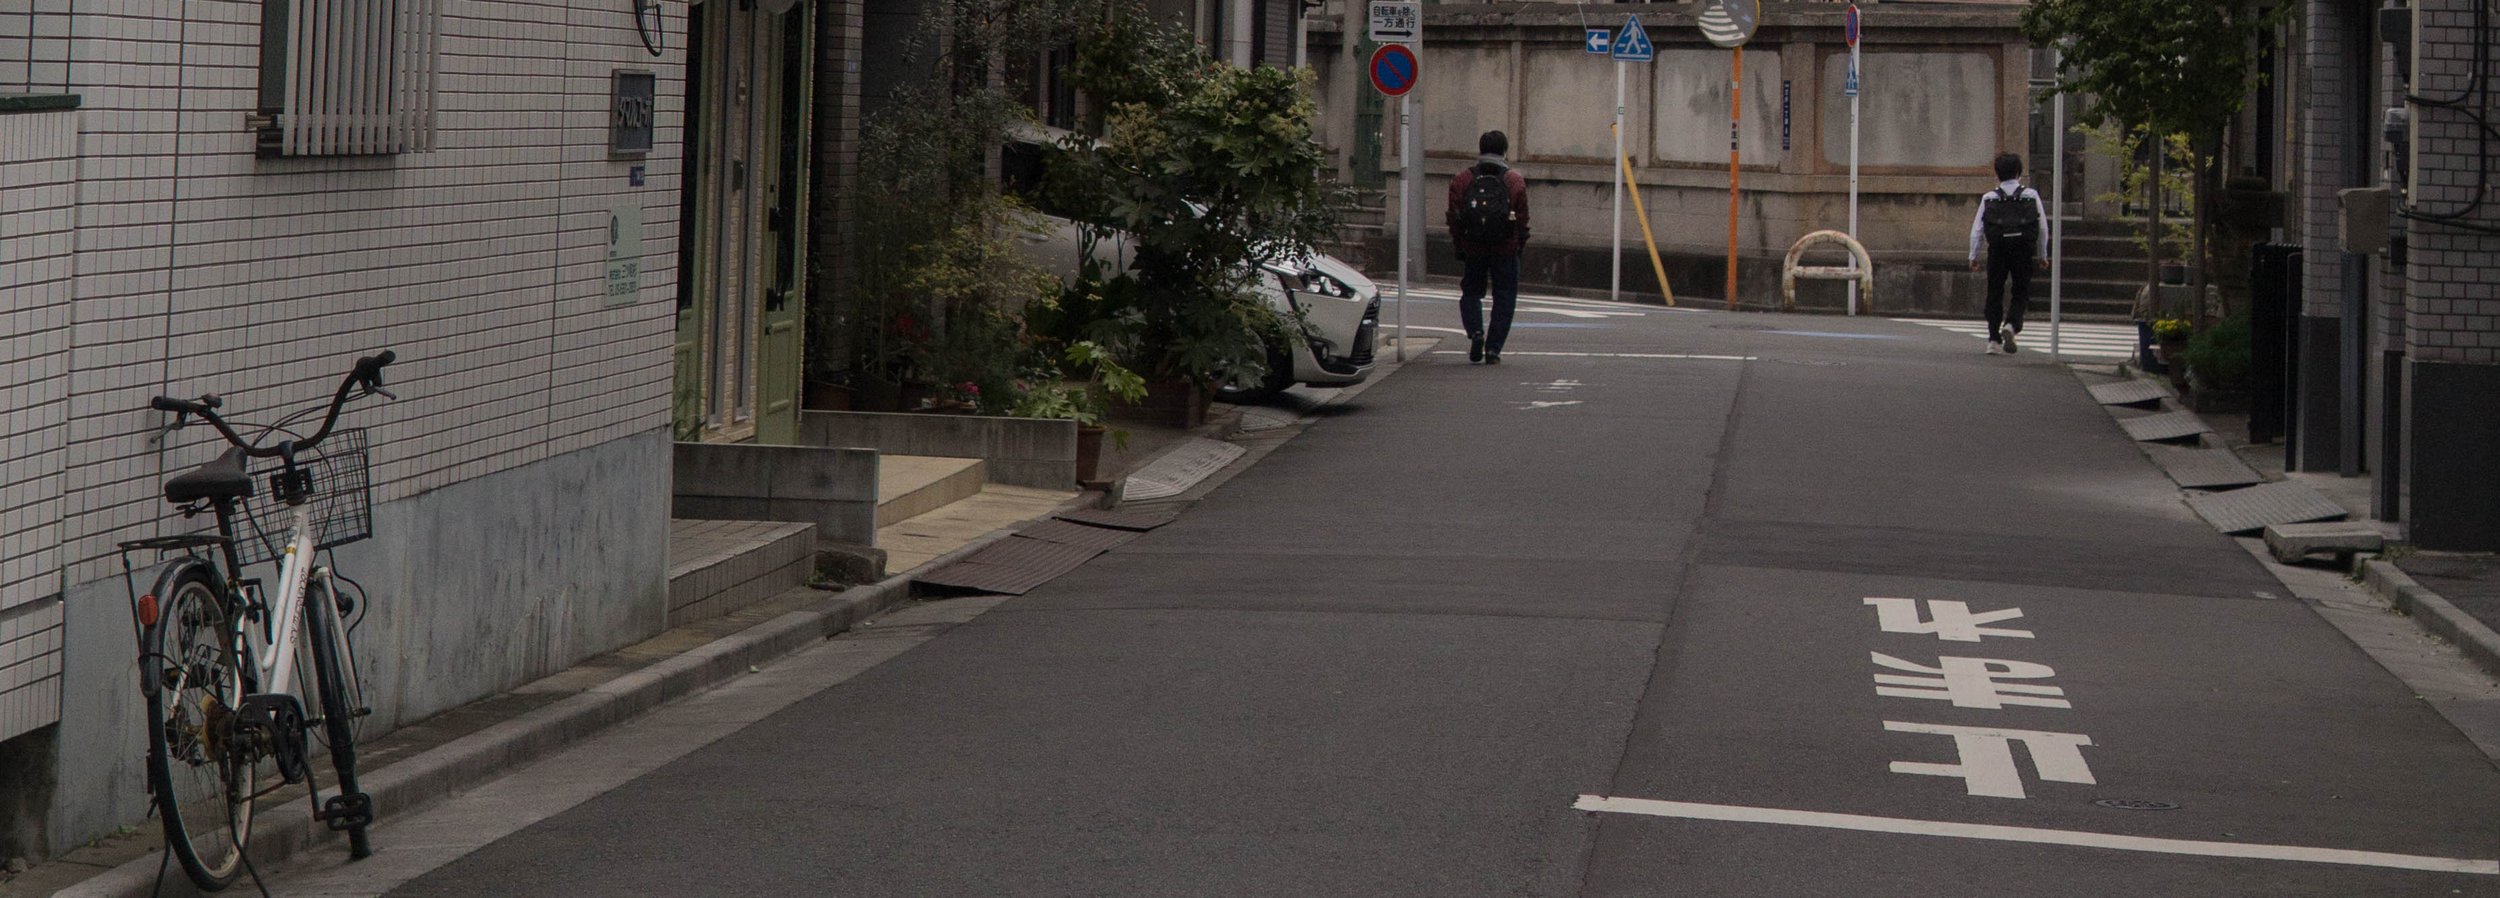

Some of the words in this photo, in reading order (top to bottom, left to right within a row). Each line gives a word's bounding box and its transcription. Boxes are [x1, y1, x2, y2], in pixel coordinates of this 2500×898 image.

[1373, 6, 1416, 17] 自転車を除く
[1373, 17, 1416, 29] 一方通行
[1863, 597, 2098, 799] 止まれ
